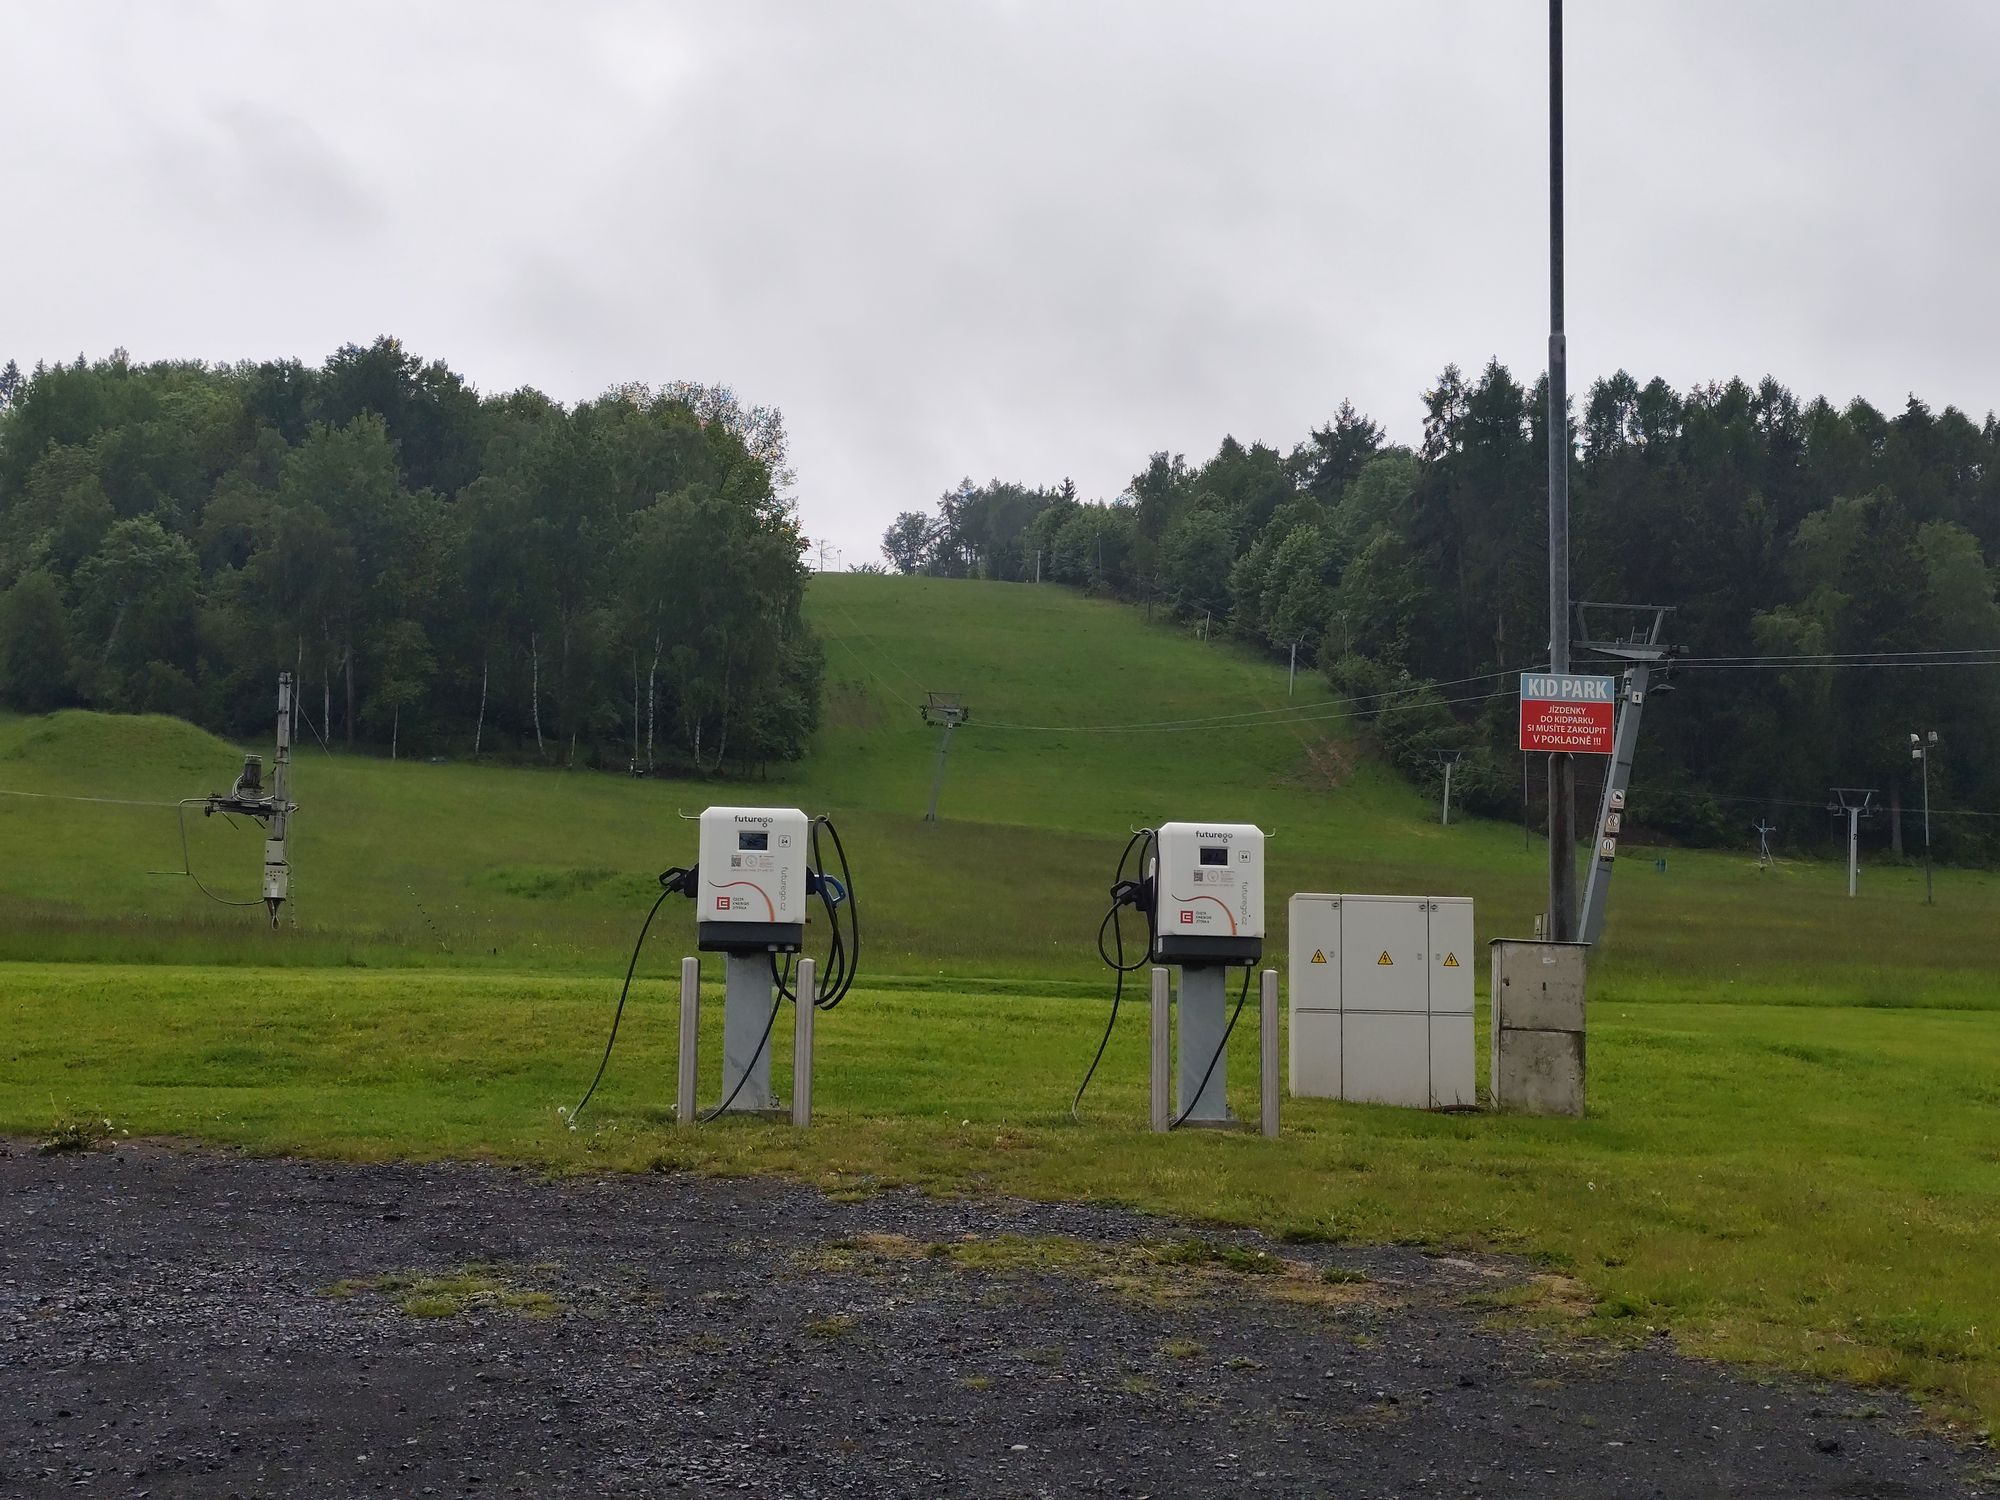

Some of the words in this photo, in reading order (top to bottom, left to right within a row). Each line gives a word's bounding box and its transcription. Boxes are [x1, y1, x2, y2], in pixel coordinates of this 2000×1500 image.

[1528, 678, 1558, 697] KID
[1561, 679, 1608, 699] PARK
[1547, 705, 1587, 715] JÍZDENKY
[1554, 716, 1594, 725] KIDPARKU
[1536, 724, 1566, 733] MUSÍTE
[1567, 726, 1607, 735] ZAKOUPIT
[1533, 735, 1540, 743] V
[1541, 735, 1592, 746] POKLADNĚ
[1593, 737, 1601, 746] !!!
[734, 815, 774, 828] futurego
[1195, 830, 1234, 844] futurego
